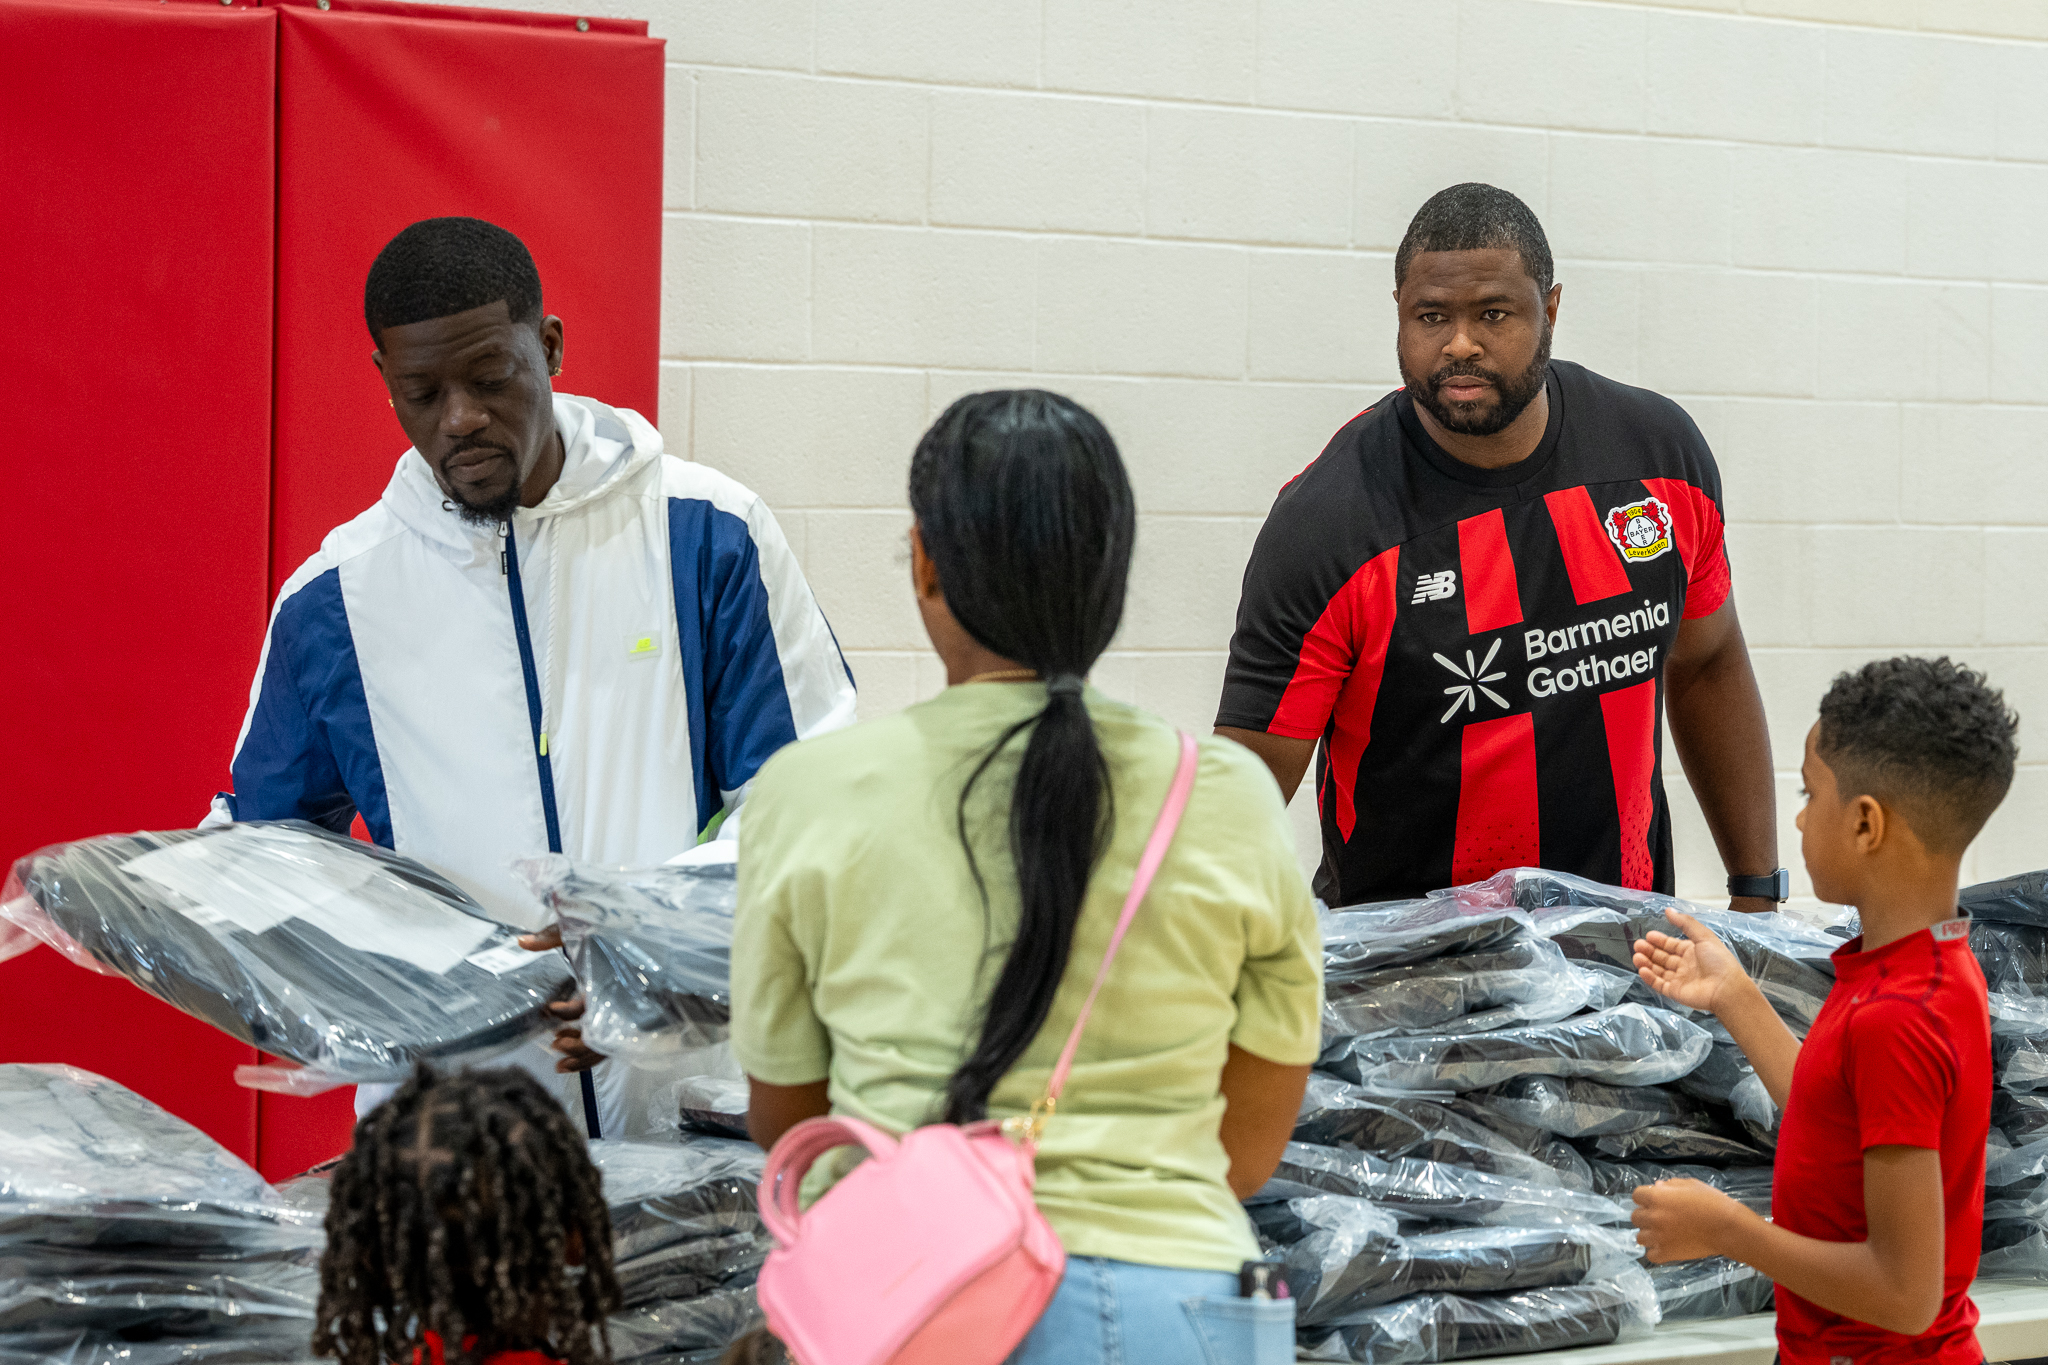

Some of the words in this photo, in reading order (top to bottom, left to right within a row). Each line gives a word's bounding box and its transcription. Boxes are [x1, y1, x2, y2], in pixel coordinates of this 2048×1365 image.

[1627, 508, 1642, 517] 1904
[1629, 526, 1654, 538] BAYER
[1635, 518, 1648, 546] BAYER
[1628, 541, 1666, 556] Leverkusen
[1411, 570, 1456, 604] NB
[1524, 599, 1669, 661] Barmenia
[1527, 645, 1658, 698] Gothaer
